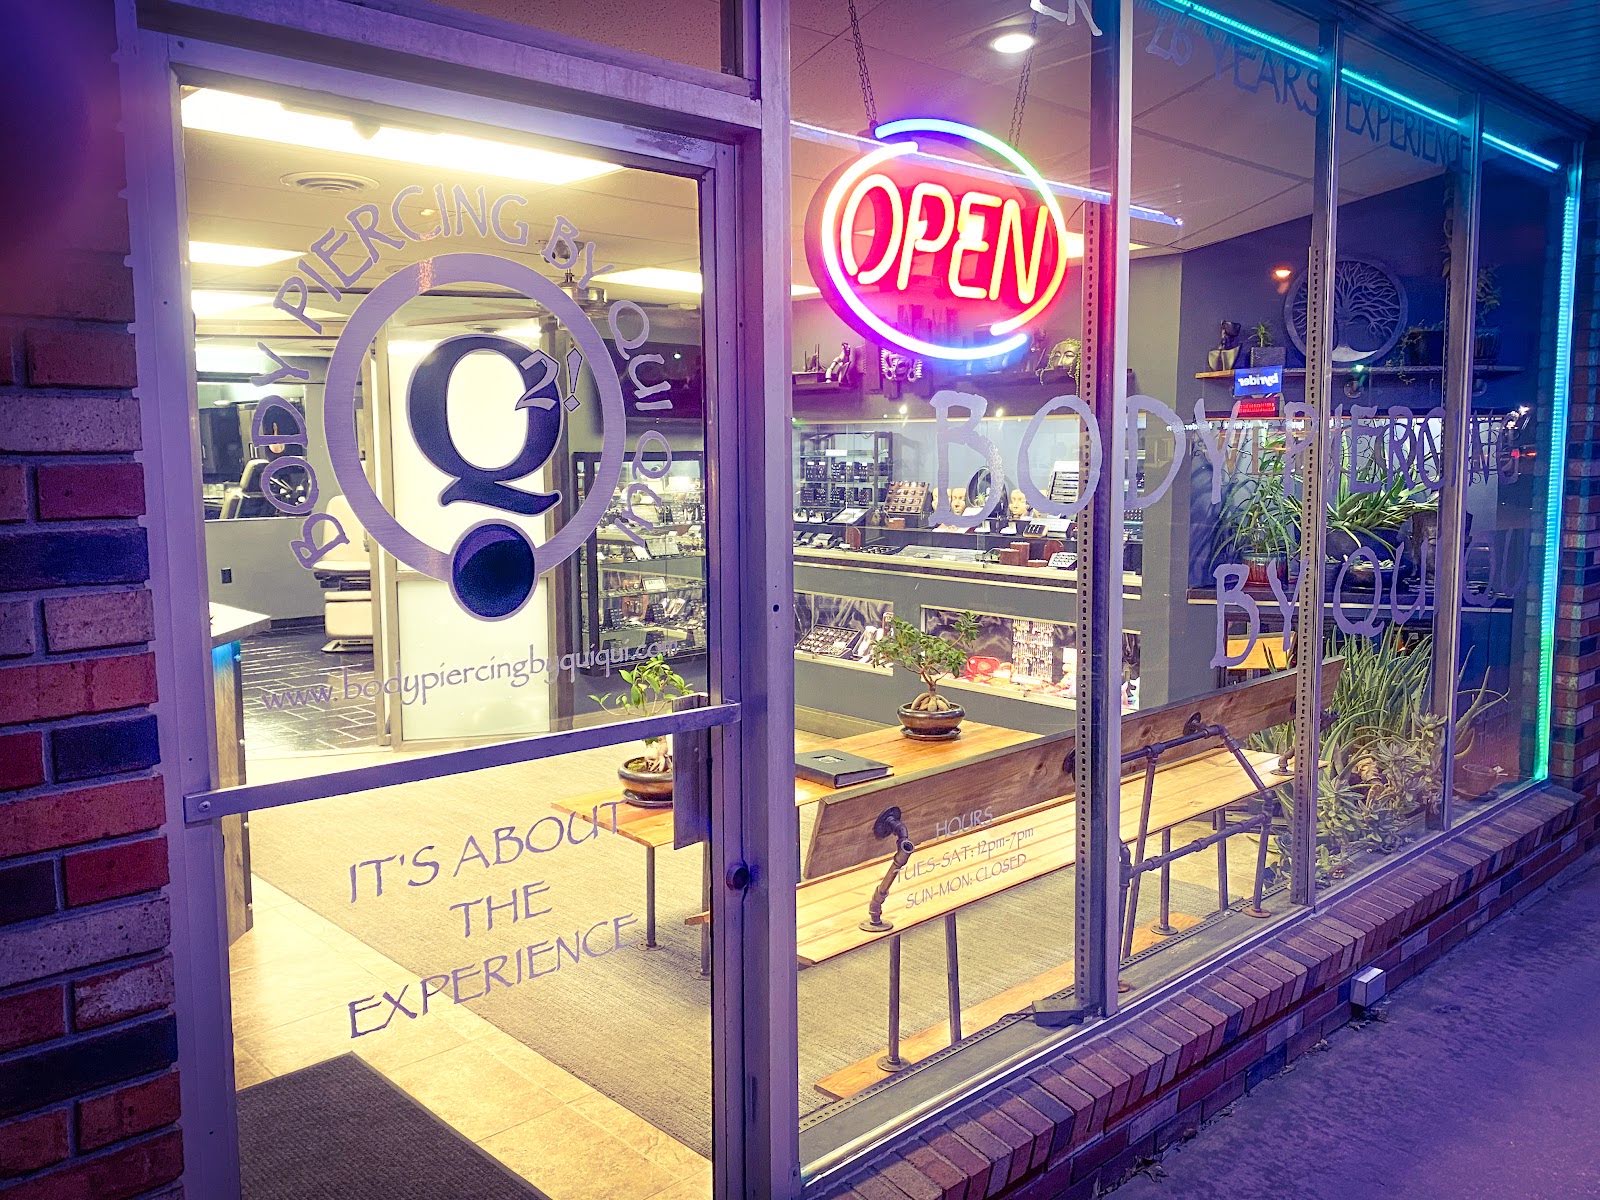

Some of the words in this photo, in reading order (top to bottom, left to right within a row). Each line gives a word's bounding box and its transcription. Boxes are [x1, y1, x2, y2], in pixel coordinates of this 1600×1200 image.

[1206, 34, 1322, 117] YEARS
[1345, 85, 1472, 174] EXPERIENCE
[273, 184, 528, 335] PIERCING
[541, 215, 614, 290] BY
[841, 174, 1048, 303] OPEN
[250, 341, 350, 570] BODY
[929, 391, 1240, 527] BODY
[1210, 557, 1308, 668] BY
[349, 845, 439, 903] IT'S
[453, 801, 627, 877] ABOUT
[894, 845, 975, 884] TUES-SAT:
[935, 806, 994, 840] HOURS
[449, 880, 553, 938] THE
[905, 872, 973, 909] SUN-MON:
[976, 853, 1027, 882] CLOSED
[348, 913, 639, 1039] EXPERIENCE
